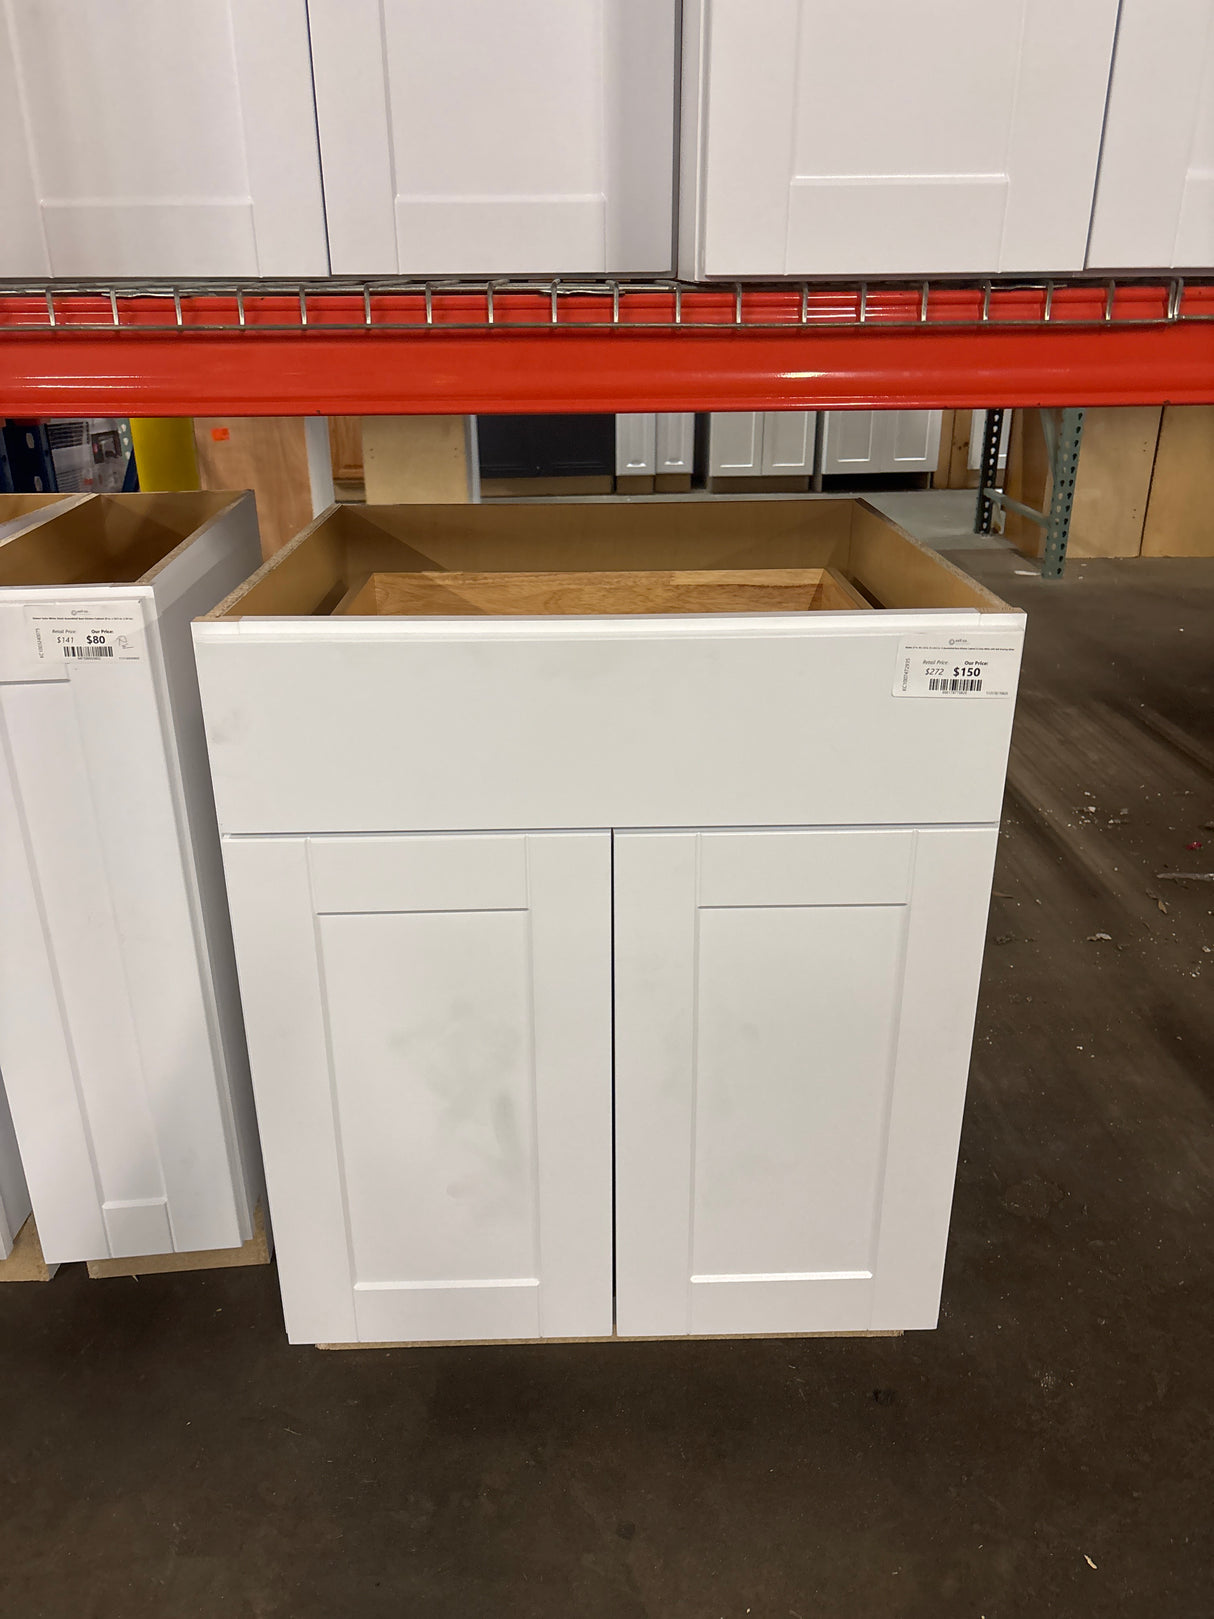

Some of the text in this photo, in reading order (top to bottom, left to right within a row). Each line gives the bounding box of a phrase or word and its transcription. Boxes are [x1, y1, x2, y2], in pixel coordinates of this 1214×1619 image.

[57, 636, 74, 644] $141
[86, 635, 106, 645] $80
[925, 668, 944, 676] $272
[953, 666, 981, 677] $150
